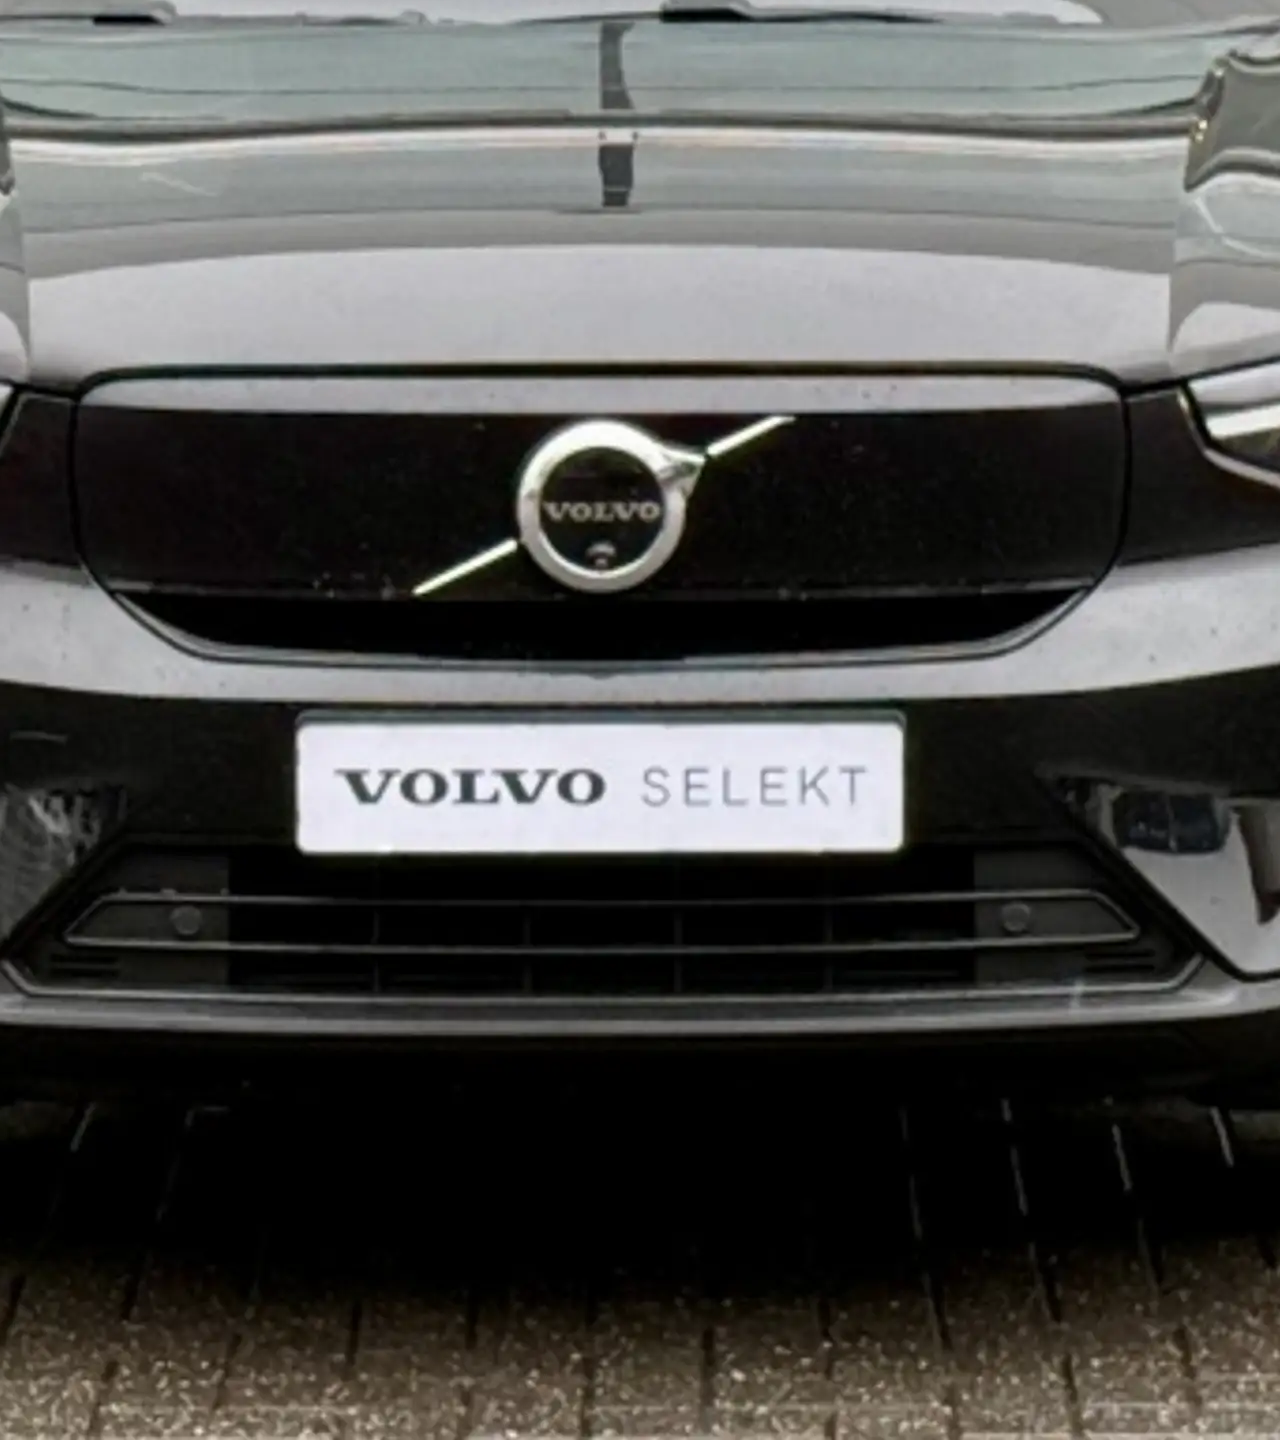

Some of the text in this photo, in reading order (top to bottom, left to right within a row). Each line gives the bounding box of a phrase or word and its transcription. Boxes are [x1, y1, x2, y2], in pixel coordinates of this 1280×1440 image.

[542, 501, 662, 522] VOLVO
[334, 765, 869, 807] VOLVO SELEKT
